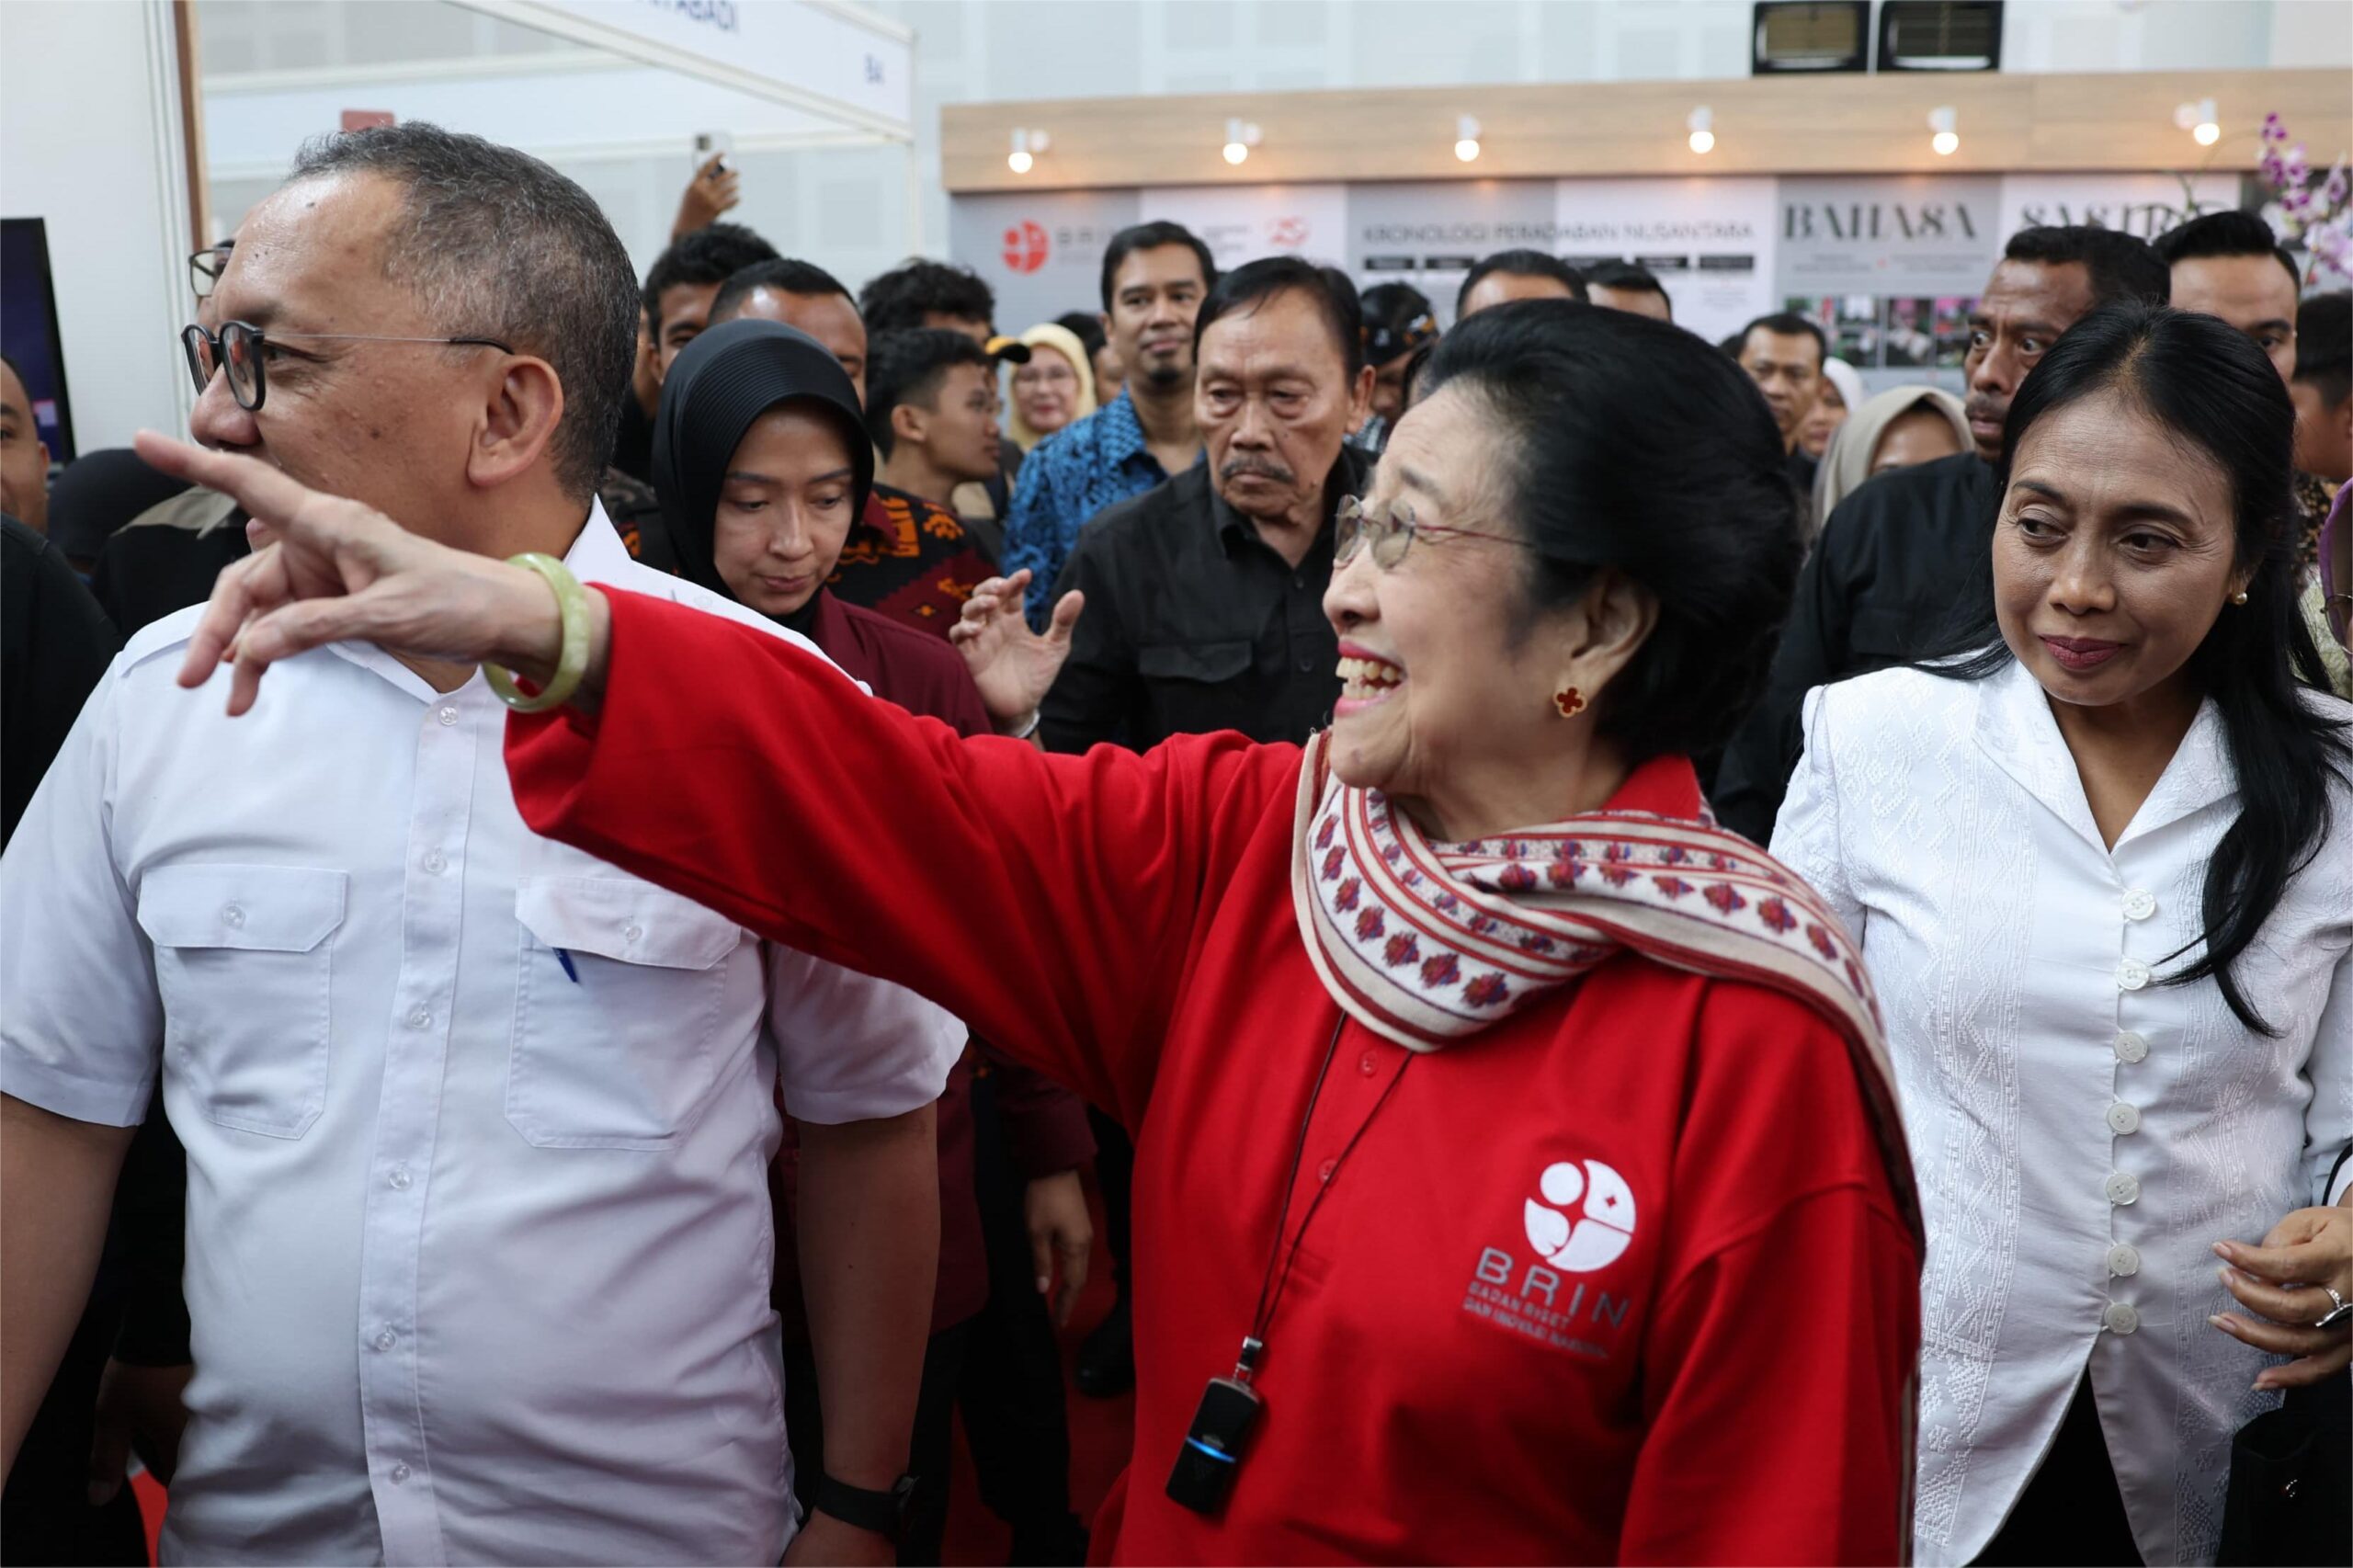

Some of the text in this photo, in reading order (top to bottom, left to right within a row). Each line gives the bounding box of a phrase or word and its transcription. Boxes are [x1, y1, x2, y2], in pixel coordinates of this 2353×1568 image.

[1363, 223, 1486, 244] KRONOLOGI
[1784, 202, 1977, 240] BAHASA
[1475, 1245, 1630, 1330] BRIN
